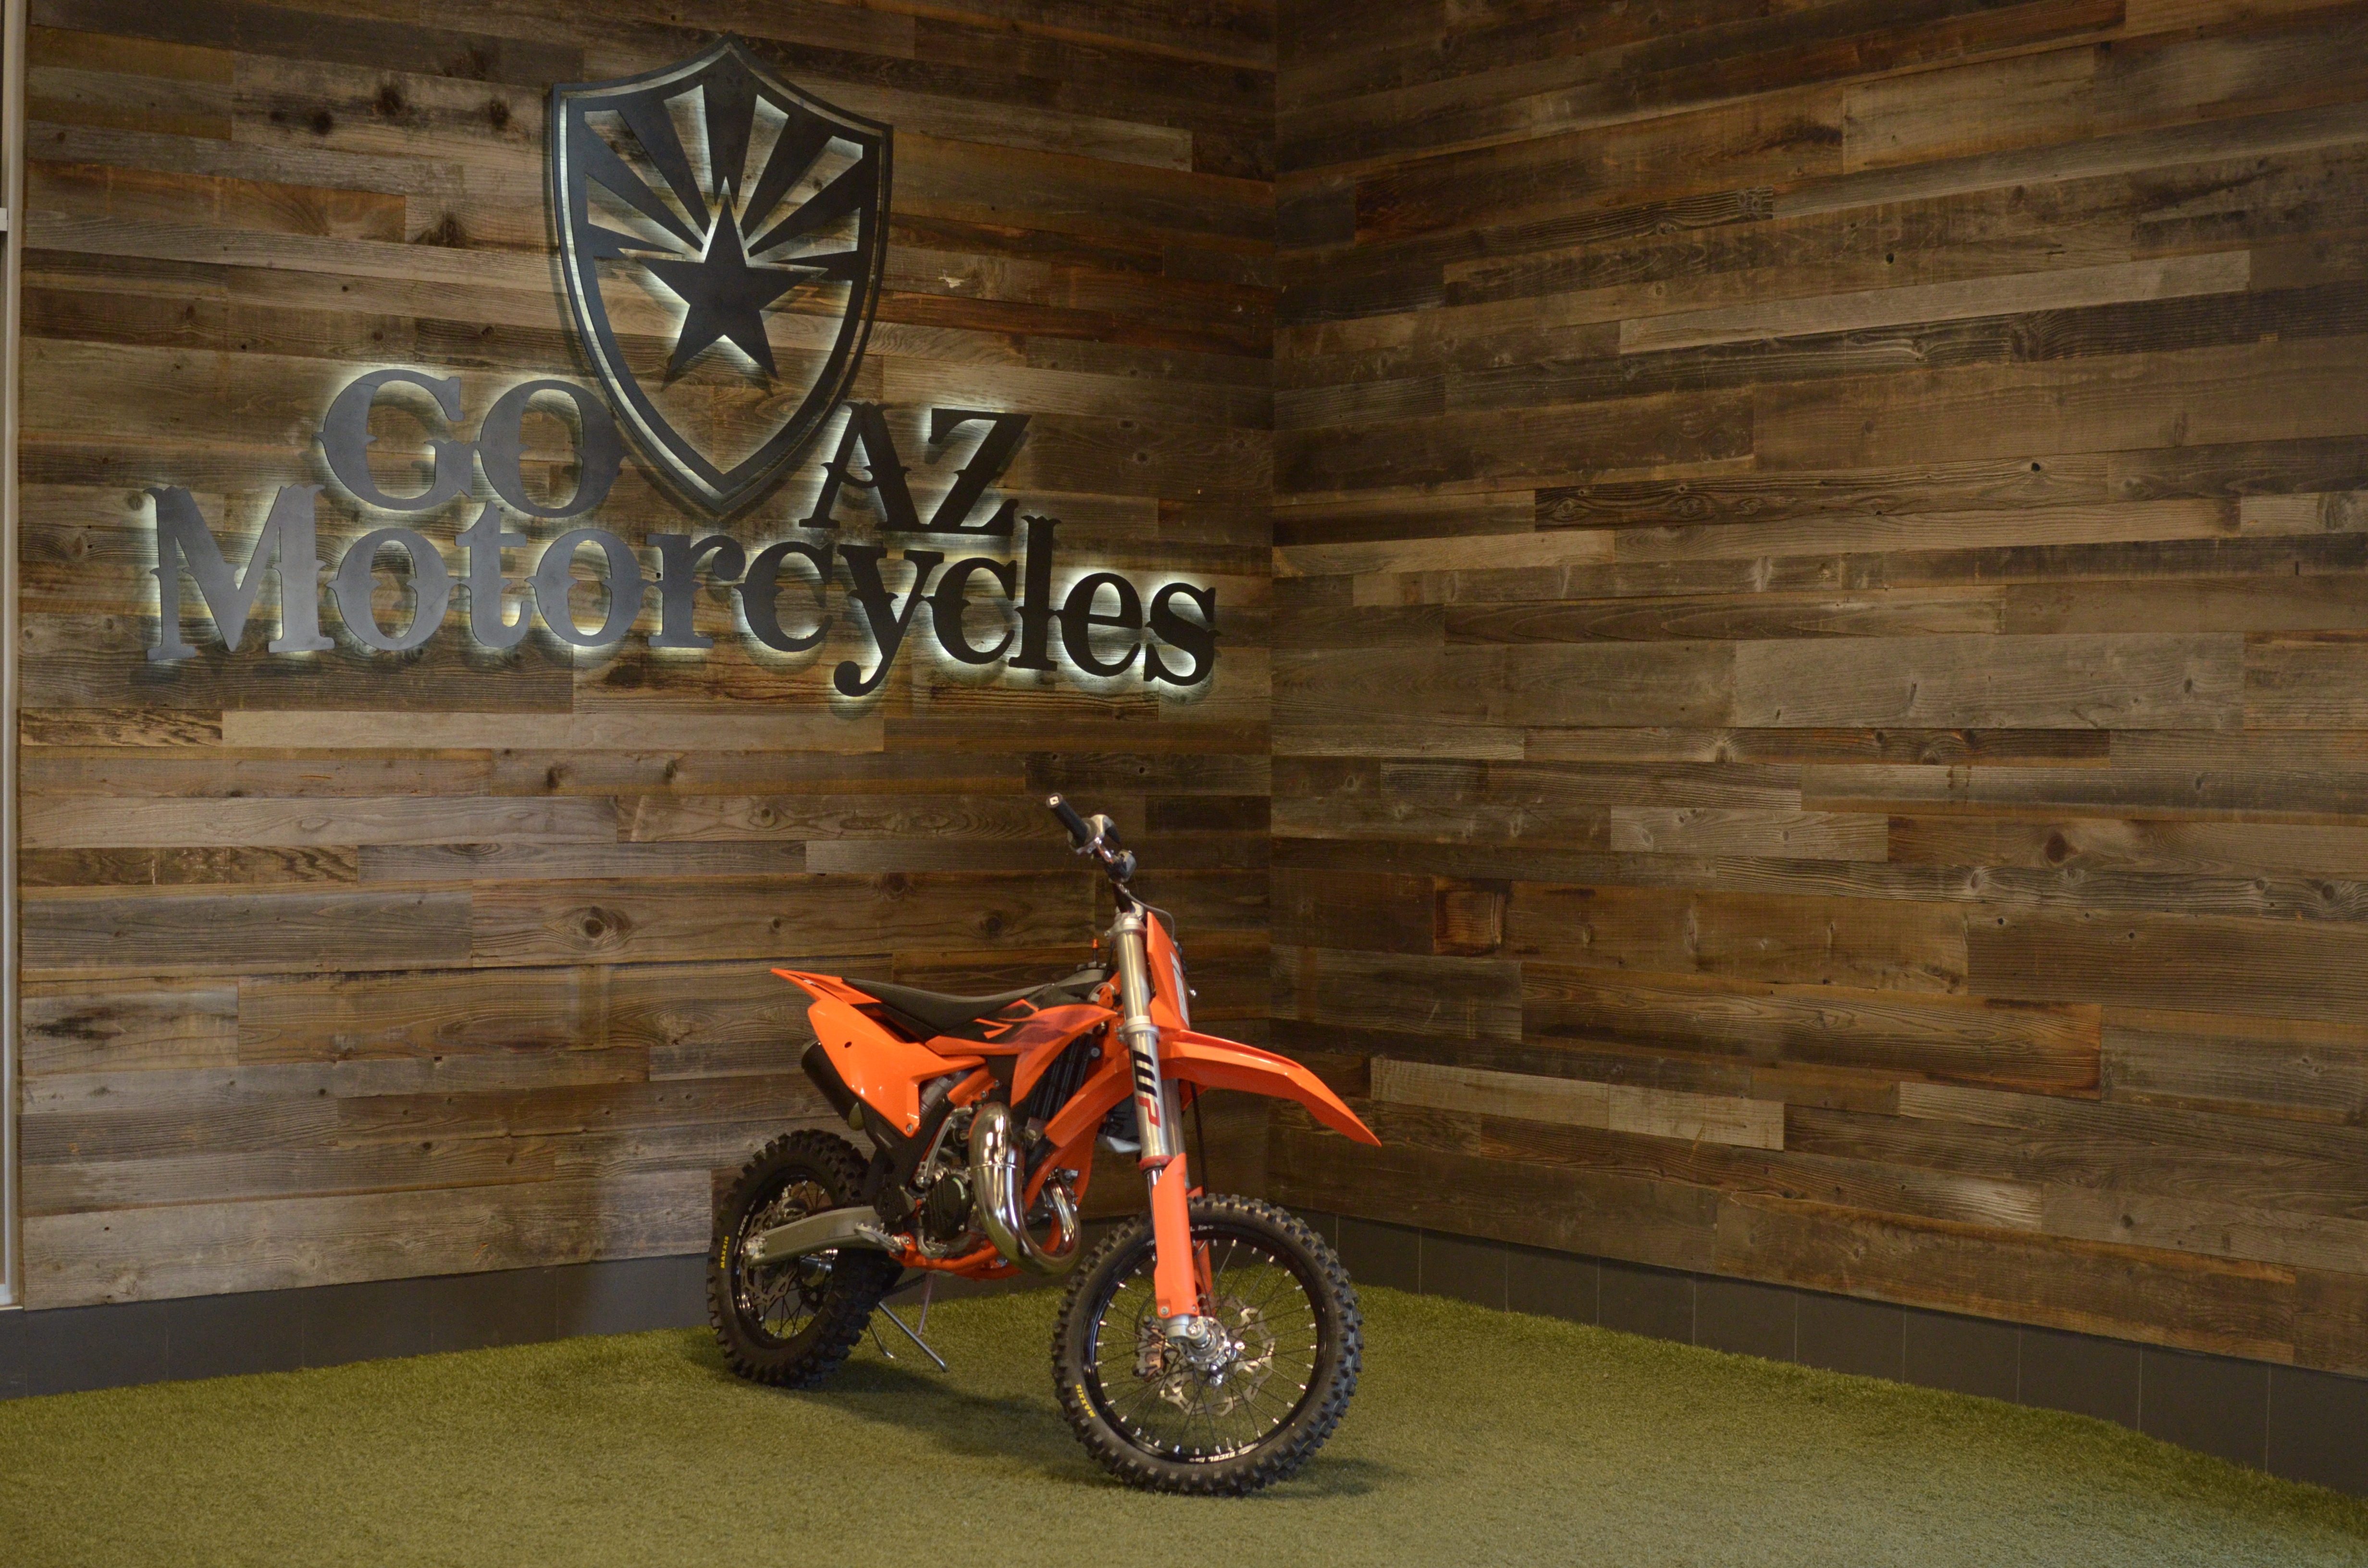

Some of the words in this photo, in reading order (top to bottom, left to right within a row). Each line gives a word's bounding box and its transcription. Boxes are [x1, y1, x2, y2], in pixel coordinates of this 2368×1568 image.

[313, 369, 632, 518] GO
[799, 402, 1032, 536] AZ
[143, 483, 1218, 697] Motorcycles
[721, 1236, 729, 1268] MAXXIS
[1075, 1384, 1096, 1418] MAXXIS
